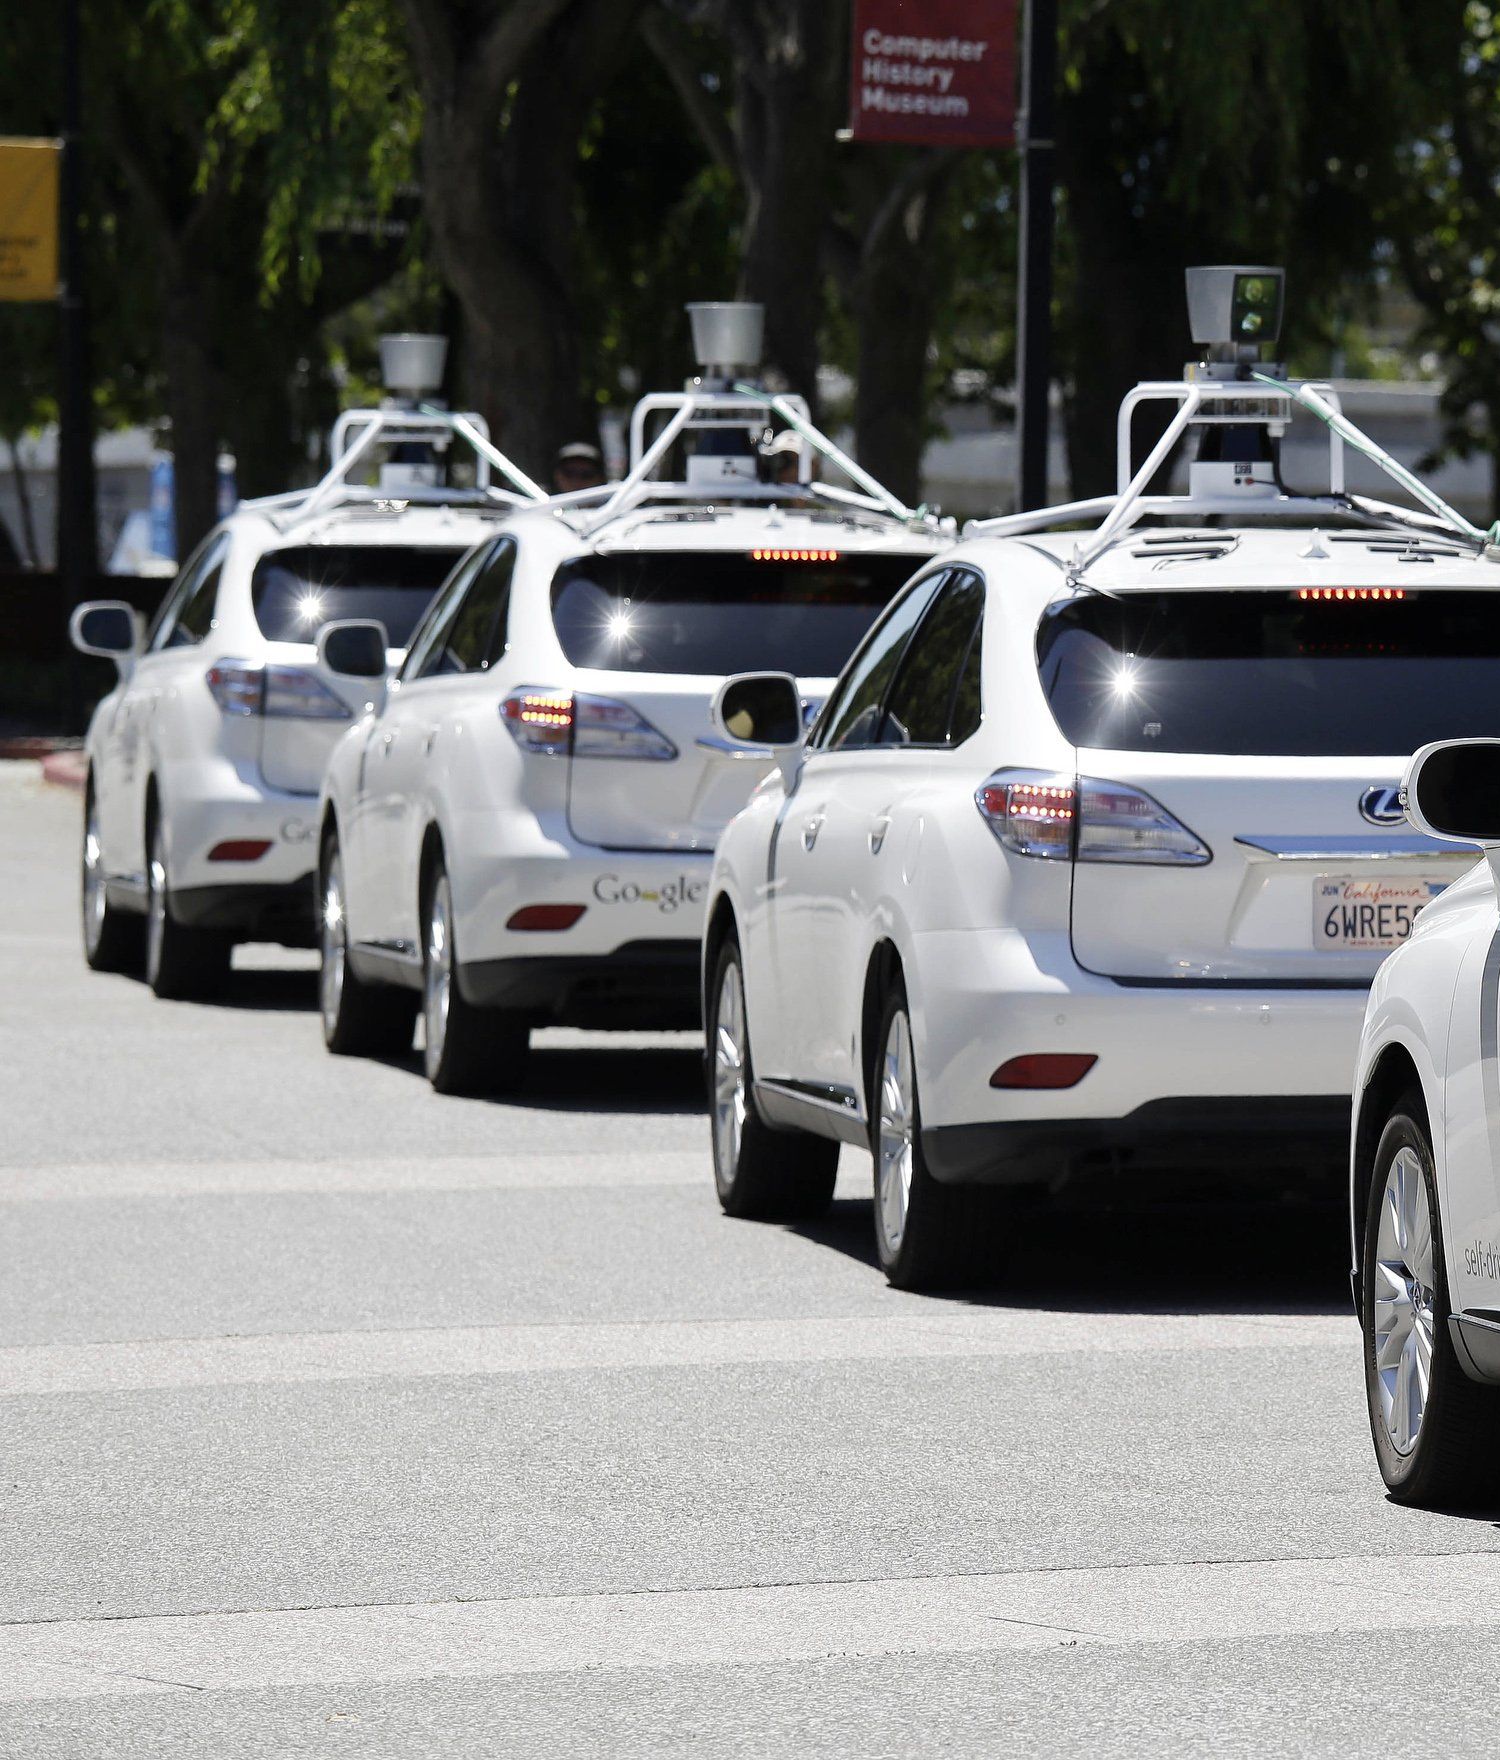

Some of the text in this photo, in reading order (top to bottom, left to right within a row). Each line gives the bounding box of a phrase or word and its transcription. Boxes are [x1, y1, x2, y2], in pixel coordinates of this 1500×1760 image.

[862, 28, 988, 61] Computer
[862, 58, 954, 93] History
[861, 86, 969, 115] Museum
[1322, 882, 1429, 904] JUN California
[1324, 904, 1423, 938] 6WRE5
